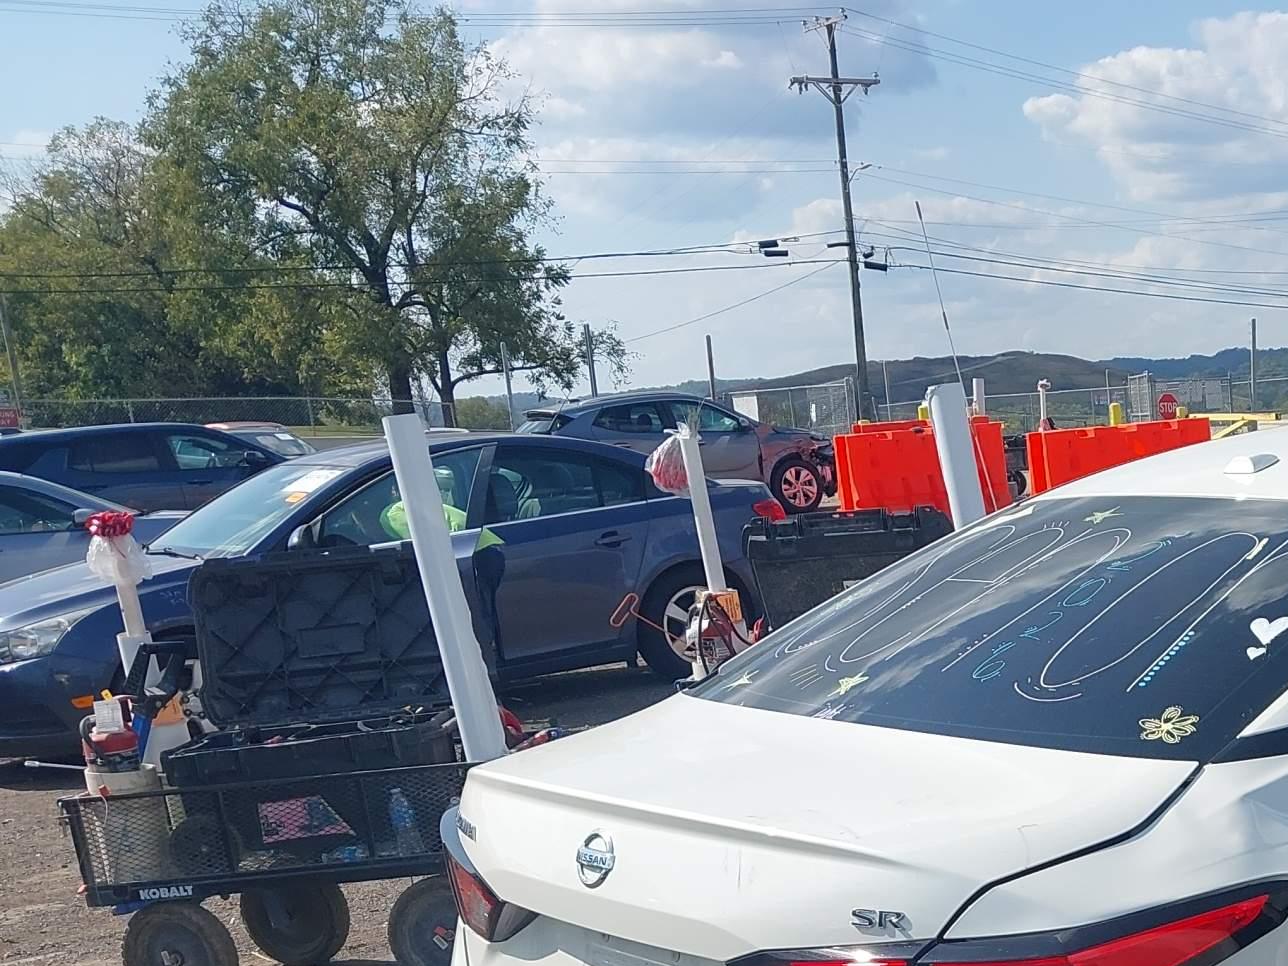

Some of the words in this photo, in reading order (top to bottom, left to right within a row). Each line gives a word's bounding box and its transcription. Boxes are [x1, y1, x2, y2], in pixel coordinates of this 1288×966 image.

[1159, 402, 1178, 413] STOP
[139, 885, 193, 900] KOBALT
[851, 908, 906, 931] SR
